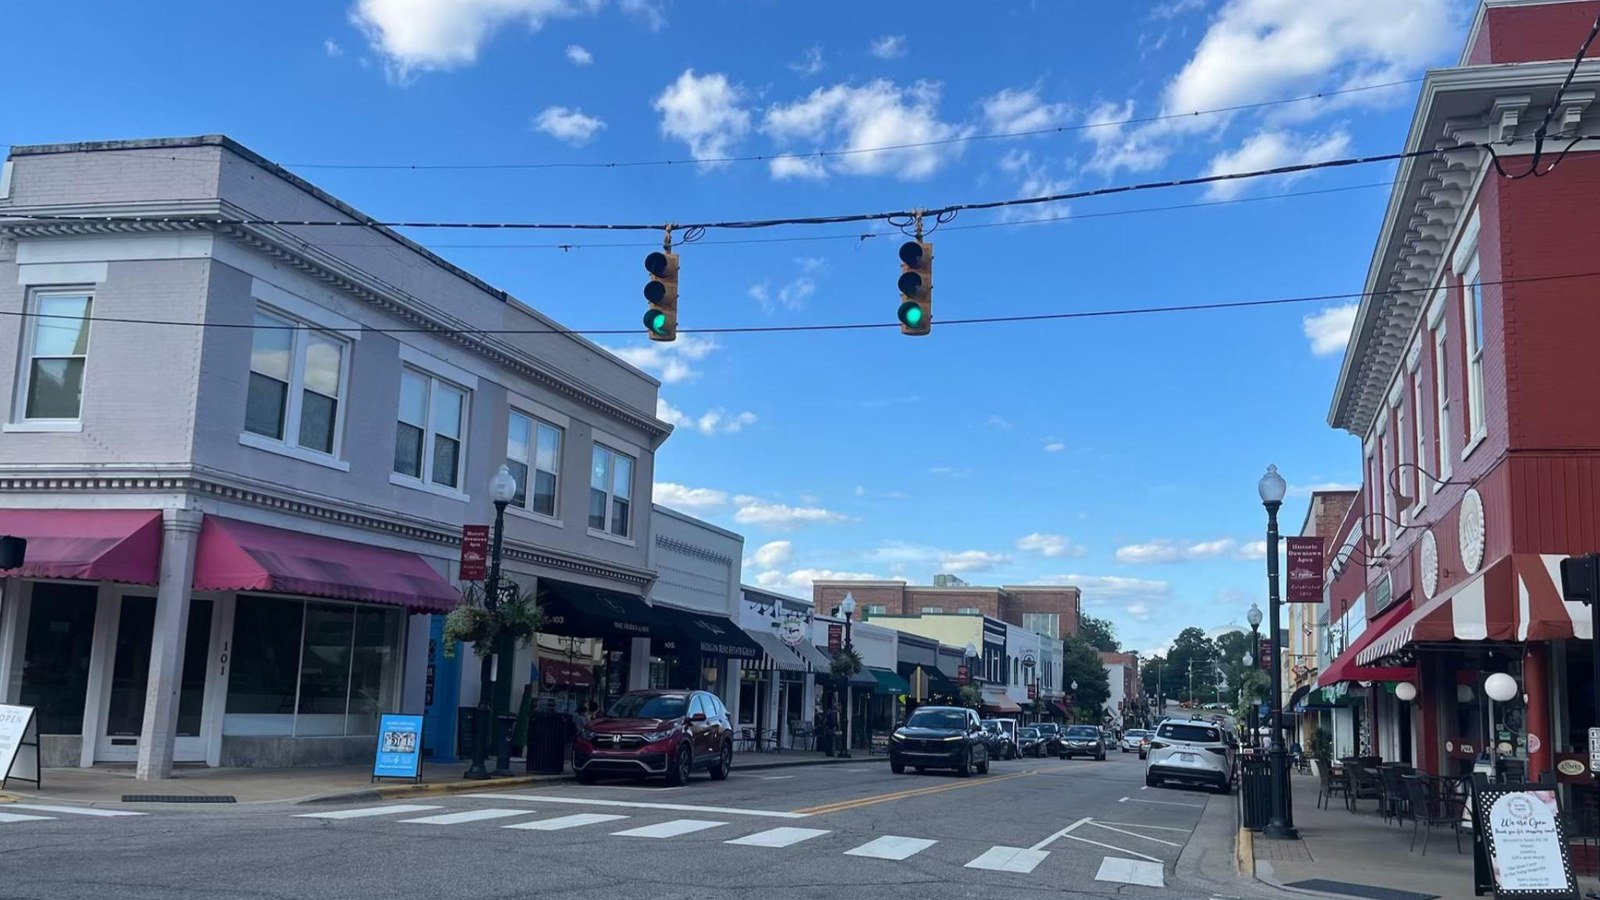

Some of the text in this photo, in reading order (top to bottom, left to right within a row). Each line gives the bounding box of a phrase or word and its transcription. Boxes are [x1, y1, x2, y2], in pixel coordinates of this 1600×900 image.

[220, 641, 228, 676] 101
[0, 714, 22, 723] OPEN
[1460, 744, 1474, 754] PIZZA
[1500, 818, 1514, 828] We
[1529, 818, 1546, 829] Open
